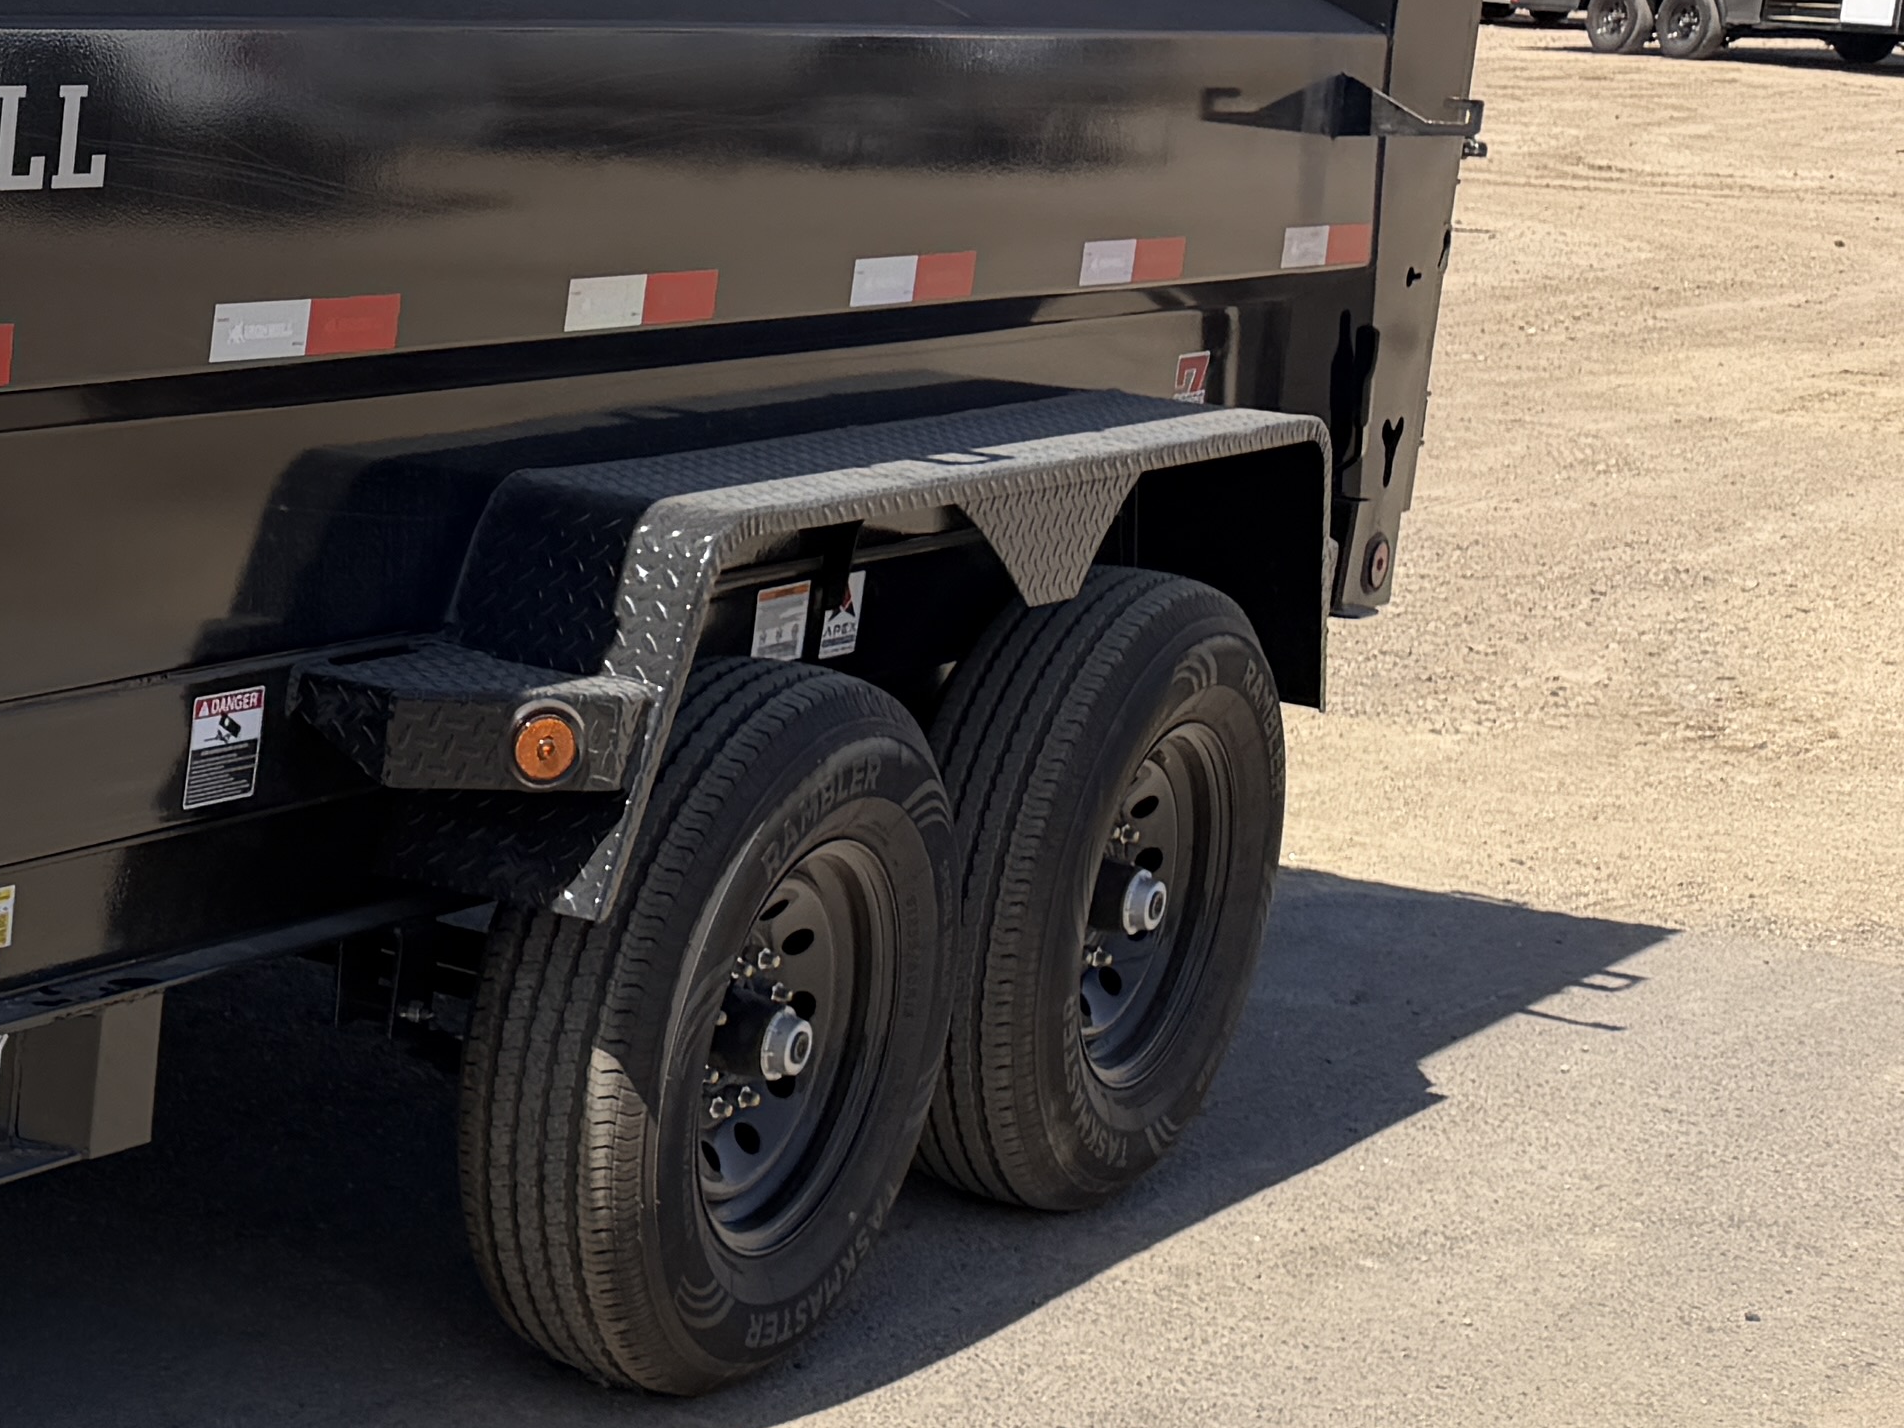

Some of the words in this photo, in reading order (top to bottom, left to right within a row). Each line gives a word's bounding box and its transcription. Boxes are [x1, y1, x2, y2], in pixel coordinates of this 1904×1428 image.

[823, 622, 856, 638] APEX
[211, 692, 258, 714] DANGER
[761, 755, 882, 881] RAMBLER
[744, 1180, 903, 1348] TASKMASTER
